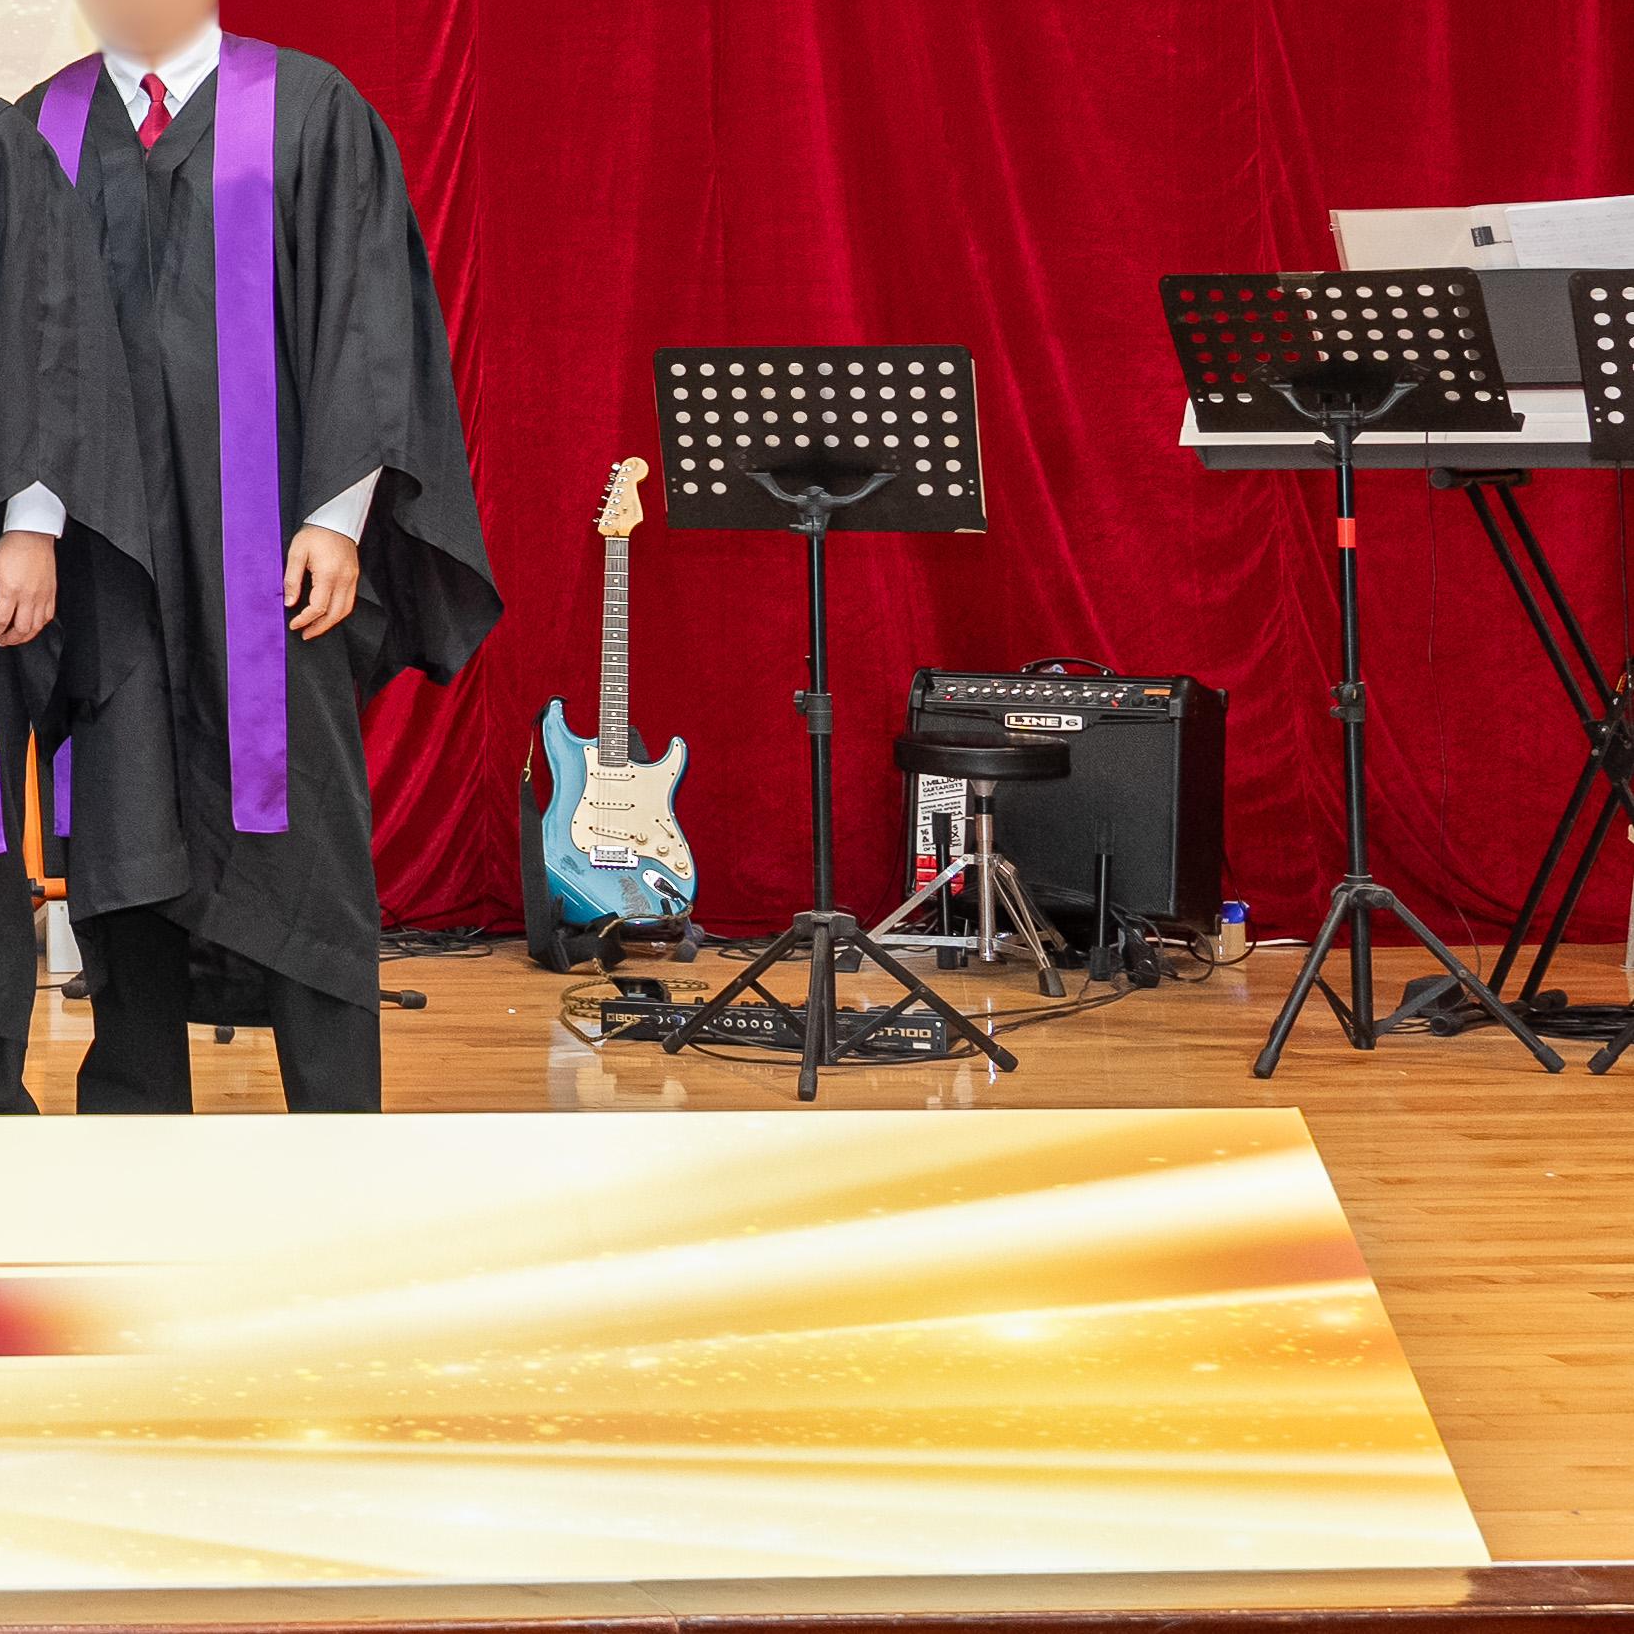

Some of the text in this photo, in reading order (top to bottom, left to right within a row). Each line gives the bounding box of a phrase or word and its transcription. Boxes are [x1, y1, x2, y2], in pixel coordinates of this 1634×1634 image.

[1008, 716, 1079, 728] LINE 6
[615, 1013, 649, 1023] BOS
